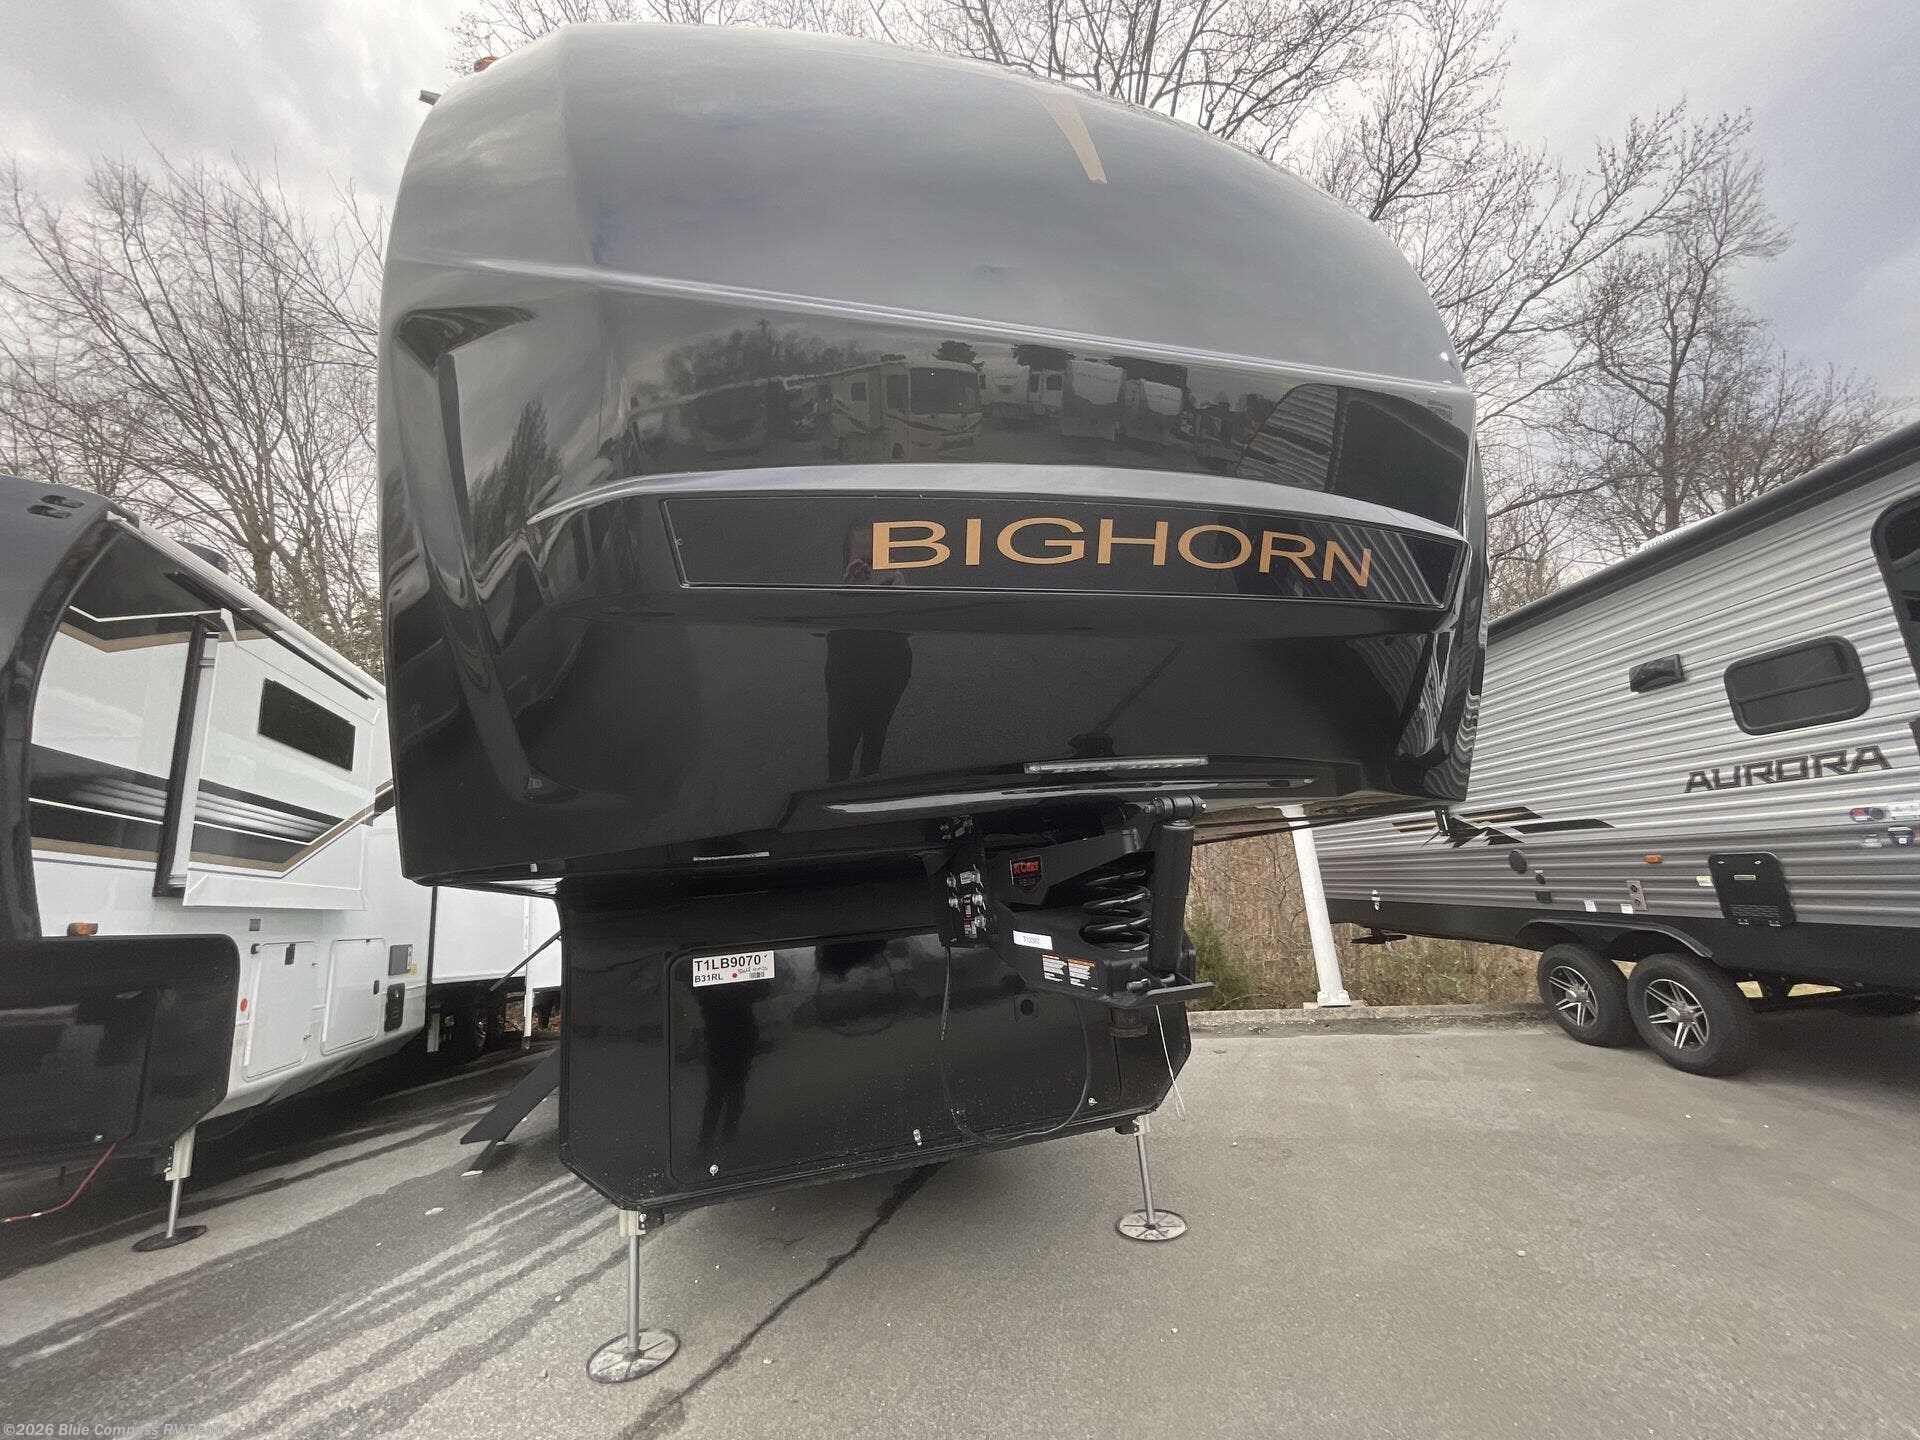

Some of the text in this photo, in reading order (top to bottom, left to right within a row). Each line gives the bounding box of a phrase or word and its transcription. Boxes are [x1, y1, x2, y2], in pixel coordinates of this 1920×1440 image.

[871, 516, 1372, 588] BIGHORN
[1684, 745, 1893, 793] AURORA
[694, 954, 762, 972] T1LB9070
[694, 973, 723, 983] B31RL
